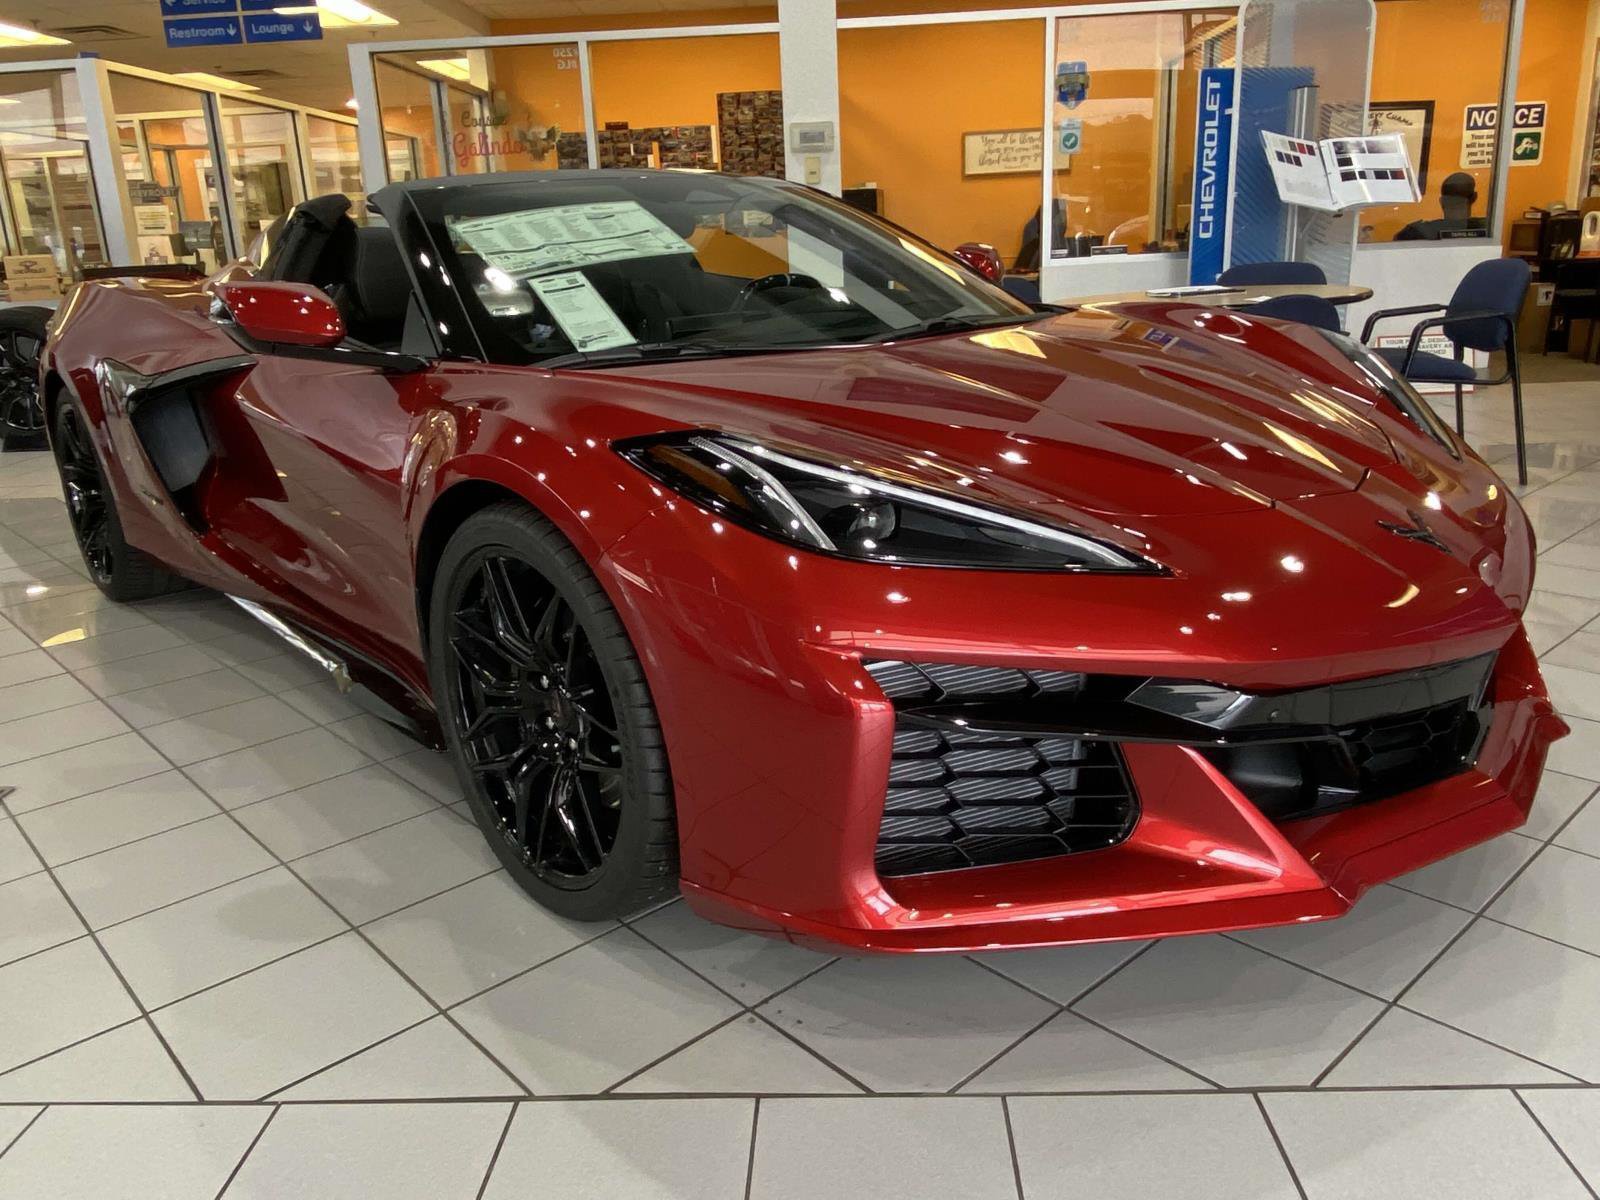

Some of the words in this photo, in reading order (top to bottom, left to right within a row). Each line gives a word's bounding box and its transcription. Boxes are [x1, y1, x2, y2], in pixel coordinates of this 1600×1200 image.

[169, 26, 225, 39] Restroom
[252, 22, 295, 35] Lounge
[1470, 107, 1542, 127] NOCE
[453, 132, 525, 168] Galindo
[1199, 76, 1221, 239] CHEVROLET
